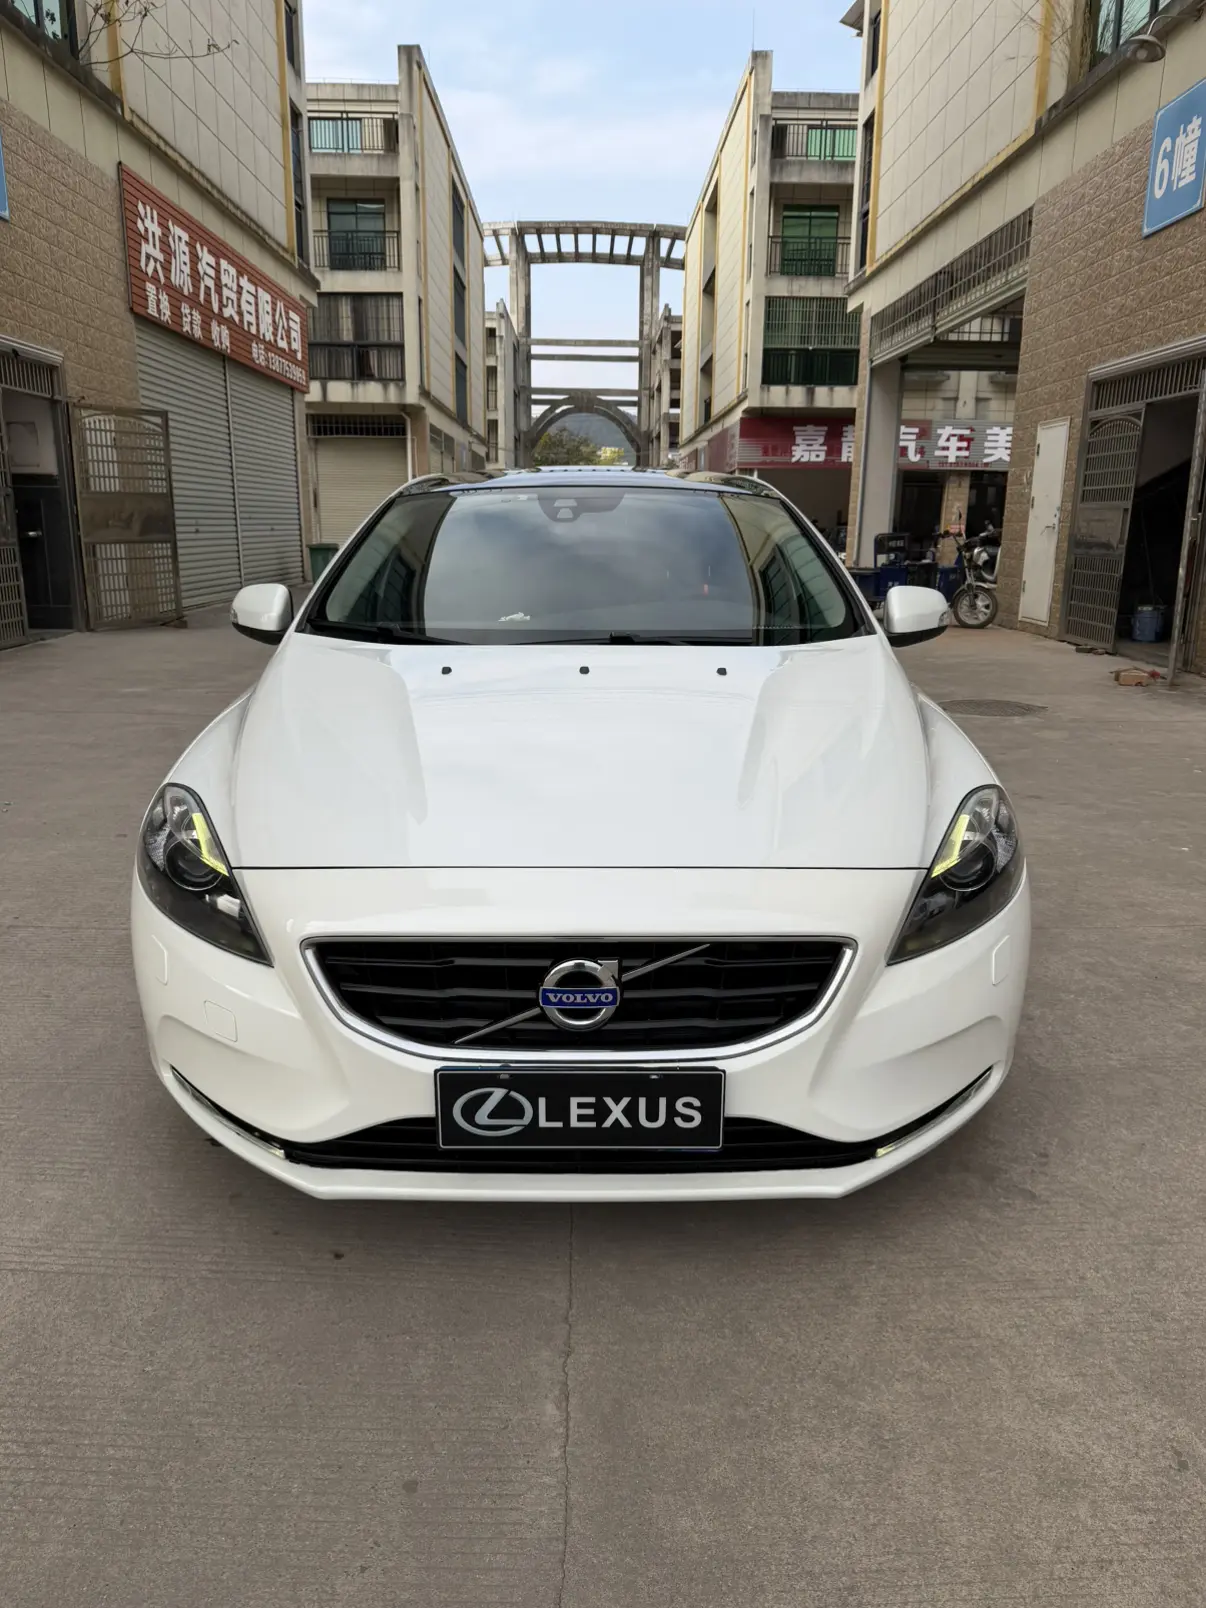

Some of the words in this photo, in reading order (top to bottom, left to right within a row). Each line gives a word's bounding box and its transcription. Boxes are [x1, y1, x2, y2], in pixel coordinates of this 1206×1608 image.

[1154, 114, 1203, 199] 6幢
[136, 199, 302, 361] 洪源汽贸有限公司
[145, 281, 172, 325] 置换
[181, 302, 203, 340] 贷款
[211, 319, 231, 353] 收购
[545, 992, 614, 1004] VOLVO
[538, 1096, 702, 1129] LEXUS
